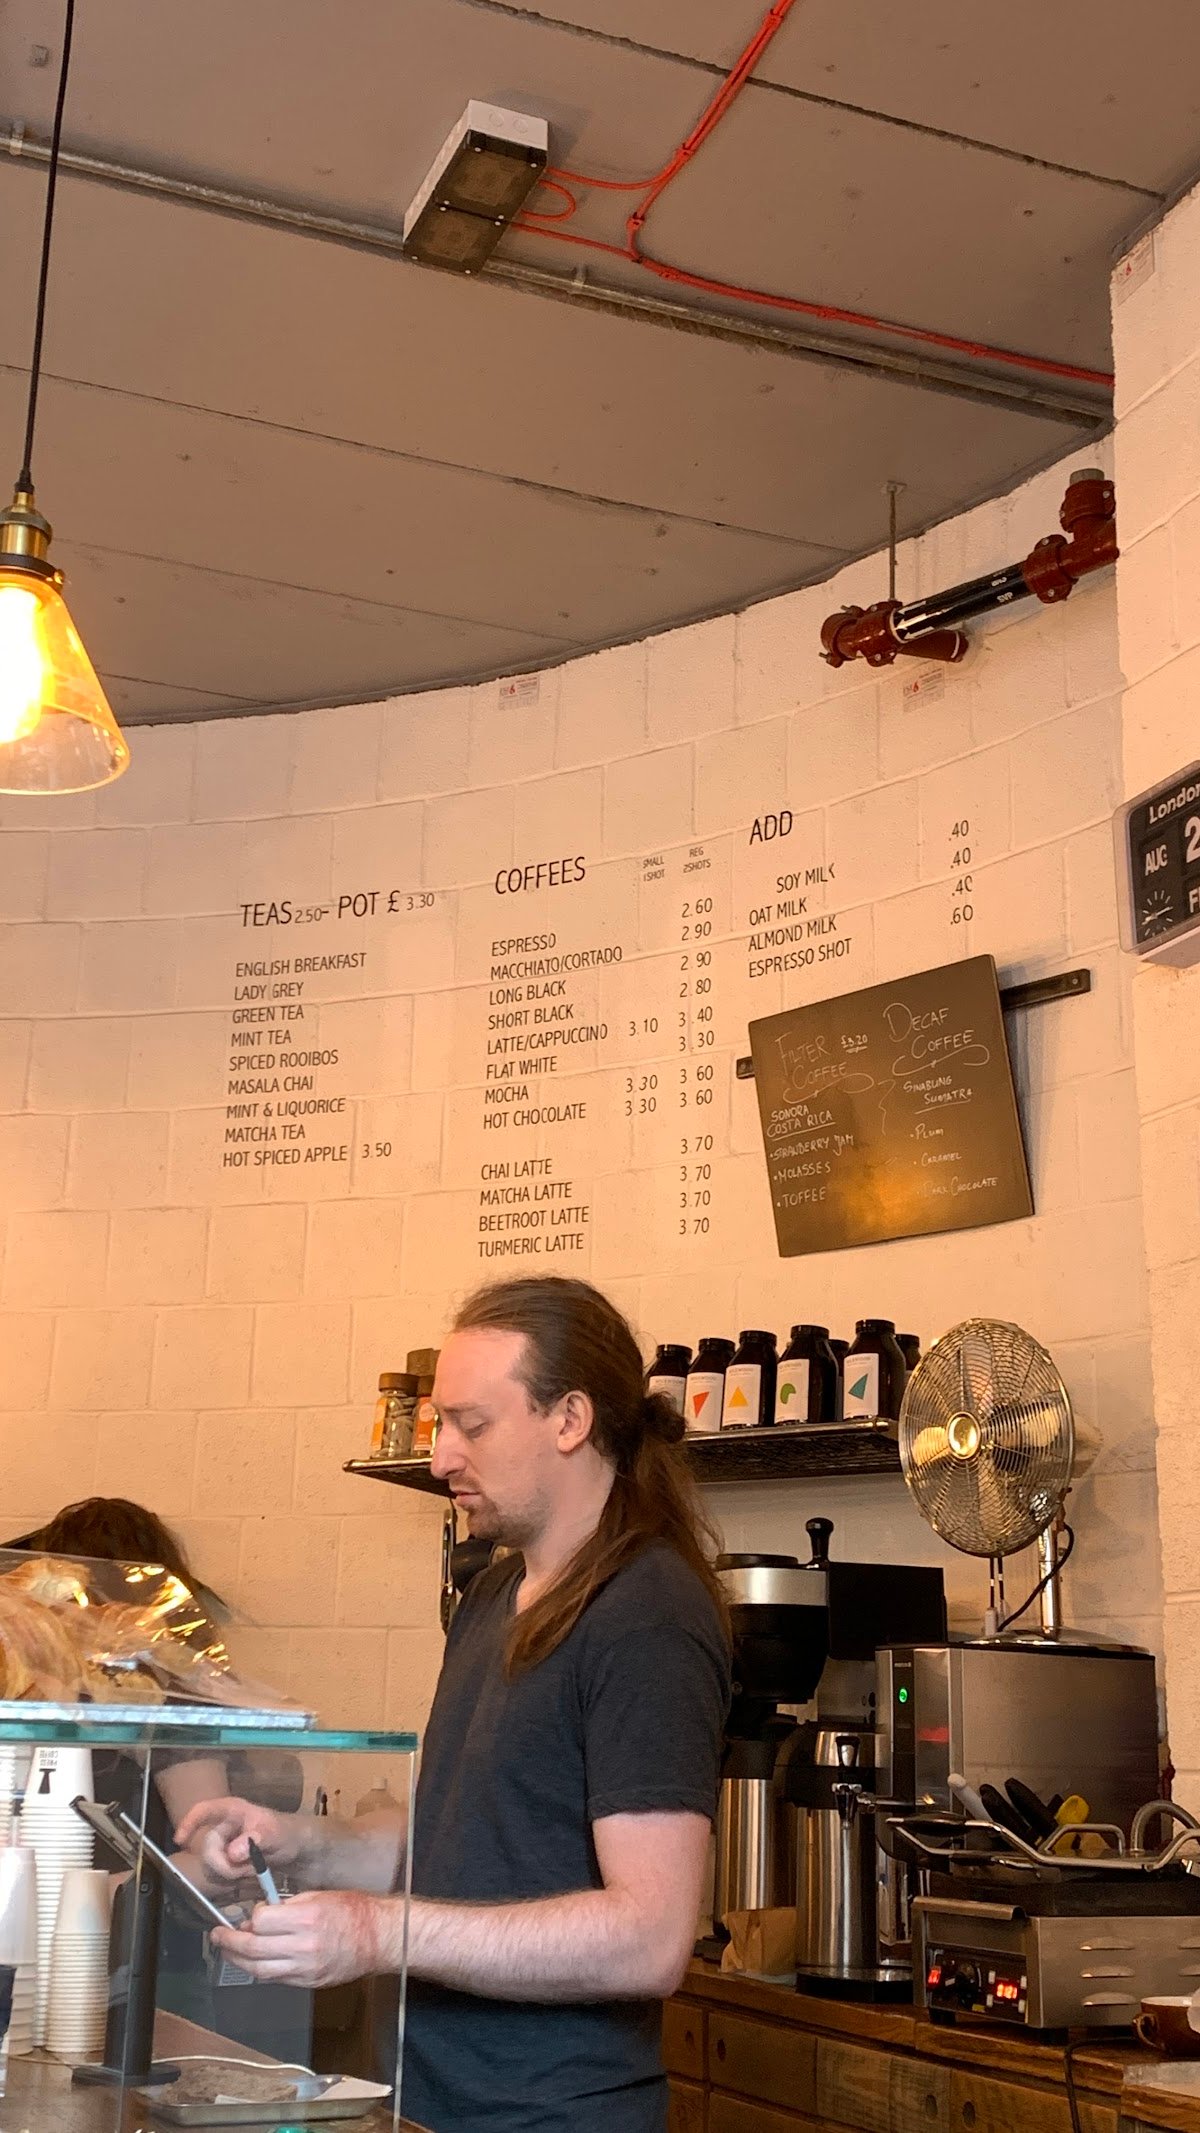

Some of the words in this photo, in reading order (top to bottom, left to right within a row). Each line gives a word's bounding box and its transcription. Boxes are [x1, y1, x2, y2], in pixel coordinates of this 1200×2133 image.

[749, 810, 793, 846] ADD
[948, 820, 969, 841] .40
[642, 856, 665, 869] SMALL
[688, 846, 704, 858] REG
[950, 847, 971, 869] .40
[1145, 844, 1168, 876] AUG
[495, 856, 586, 895] COFFEES
[776, 872, 801, 893] SOY
[805, 862, 836, 886] MILK
[951, 875, 973, 897] .40
[240, 901, 292, 927] TEAS
[338, 892, 380, 919] POT
[681, 897, 713, 919] 2.60
[749, 905, 773, 926] OAT
[776, 897, 807, 919] MILK
[950, 904, 974, 926] .60
[681, 921, 712, 941] 2.90
[748, 925, 803, 952] ALMOND
[807, 914, 837, 938] MILK
[491, 933, 557, 957] ESPRESSO
[236, 960, 290, 978] ENGLISH
[294, 953, 367, 973] BREAKFAST
[490, 946, 623, 981] MACCHIATO/CORTADO
[680, 950, 712, 971] 2.90
[749, 948, 815, 978] ESPRESSO
[818, 938, 852, 962] SHOT
[234, 985, 267, 1001] LADY
[272, 982, 304, 999] GREY
[489, 986, 523, 1006] LONG
[526, 980, 566, 1000] BLACK
[679, 977, 712, 998] 2.80
[232, 1006, 275, 1023] GREEN
[281, 1005, 304, 1020] TEA
[488, 1010, 530, 1030] SHORT
[534, 1003, 574, 1024] BLACK
[882, 1002, 949, 1043] DECAF
[231, 1031, 263, 1047] MINT
[267, 1029, 291, 1045] TEA
[487, 1023, 608, 1055] LATTE/CAPPUCCINO
[628, 1017, 659, 1037] 3.10
[911, 1029, 974, 1059] COFFEE
[229, 1054, 275, 1071] SPICED
[280, 1049, 339, 1068] ROOIBOS
[486, 1061, 515, 1080] FLAT
[519, 1056, 558, 1075] WHITE
[228, 1077, 280, 1095] MASALA
[284, 1075, 313, 1091] CHAI
[792, 1061, 847, 1090] COFFEE
[484, 1085, 529, 1104] MOCHA
[226, 1103, 259, 1119] MINT
[263, 1102, 273, 1117] &
[277, 1098, 346, 1118] LIQUORICE
[483, 1111, 509, 1130] HOT
[513, 1102, 587, 1127] CHOCOLATE
[771, 1104, 810, 1123] SONORA
[225, 1126, 277, 1143] MATCHA
[281, 1124, 306, 1140] TEA
[766, 1118, 802, 1138] COSTA
[807, 1110, 833, 1127] RICA
[223, 1151, 250, 1168] HOT
[254, 1149, 300, 1166] SPICED
[304, 1145, 348, 1163] APPLE
[362, 1142, 392, 1159] 3.50
[680, 1134, 714, 1154] 3.70
[481, 1162, 510, 1180] CHAI
[514, 1158, 552, 1178] LATTE
[777, 1161, 831, 1184] MOLASSES
[480, 1186, 530, 1206] MATCHA
[534, 1181, 573, 1201] LATTE
[679, 1190, 711, 1209] 3.70
[782, 1186, 827, 1208] TOFFEE
[479, 1210, 547, 1232] BEETROOT
[551, 1206, 590, 1225] LATTE
[478, 1236, 542, 1258] TURMERIC
[545, 1233, 585, 1252] LATTE
